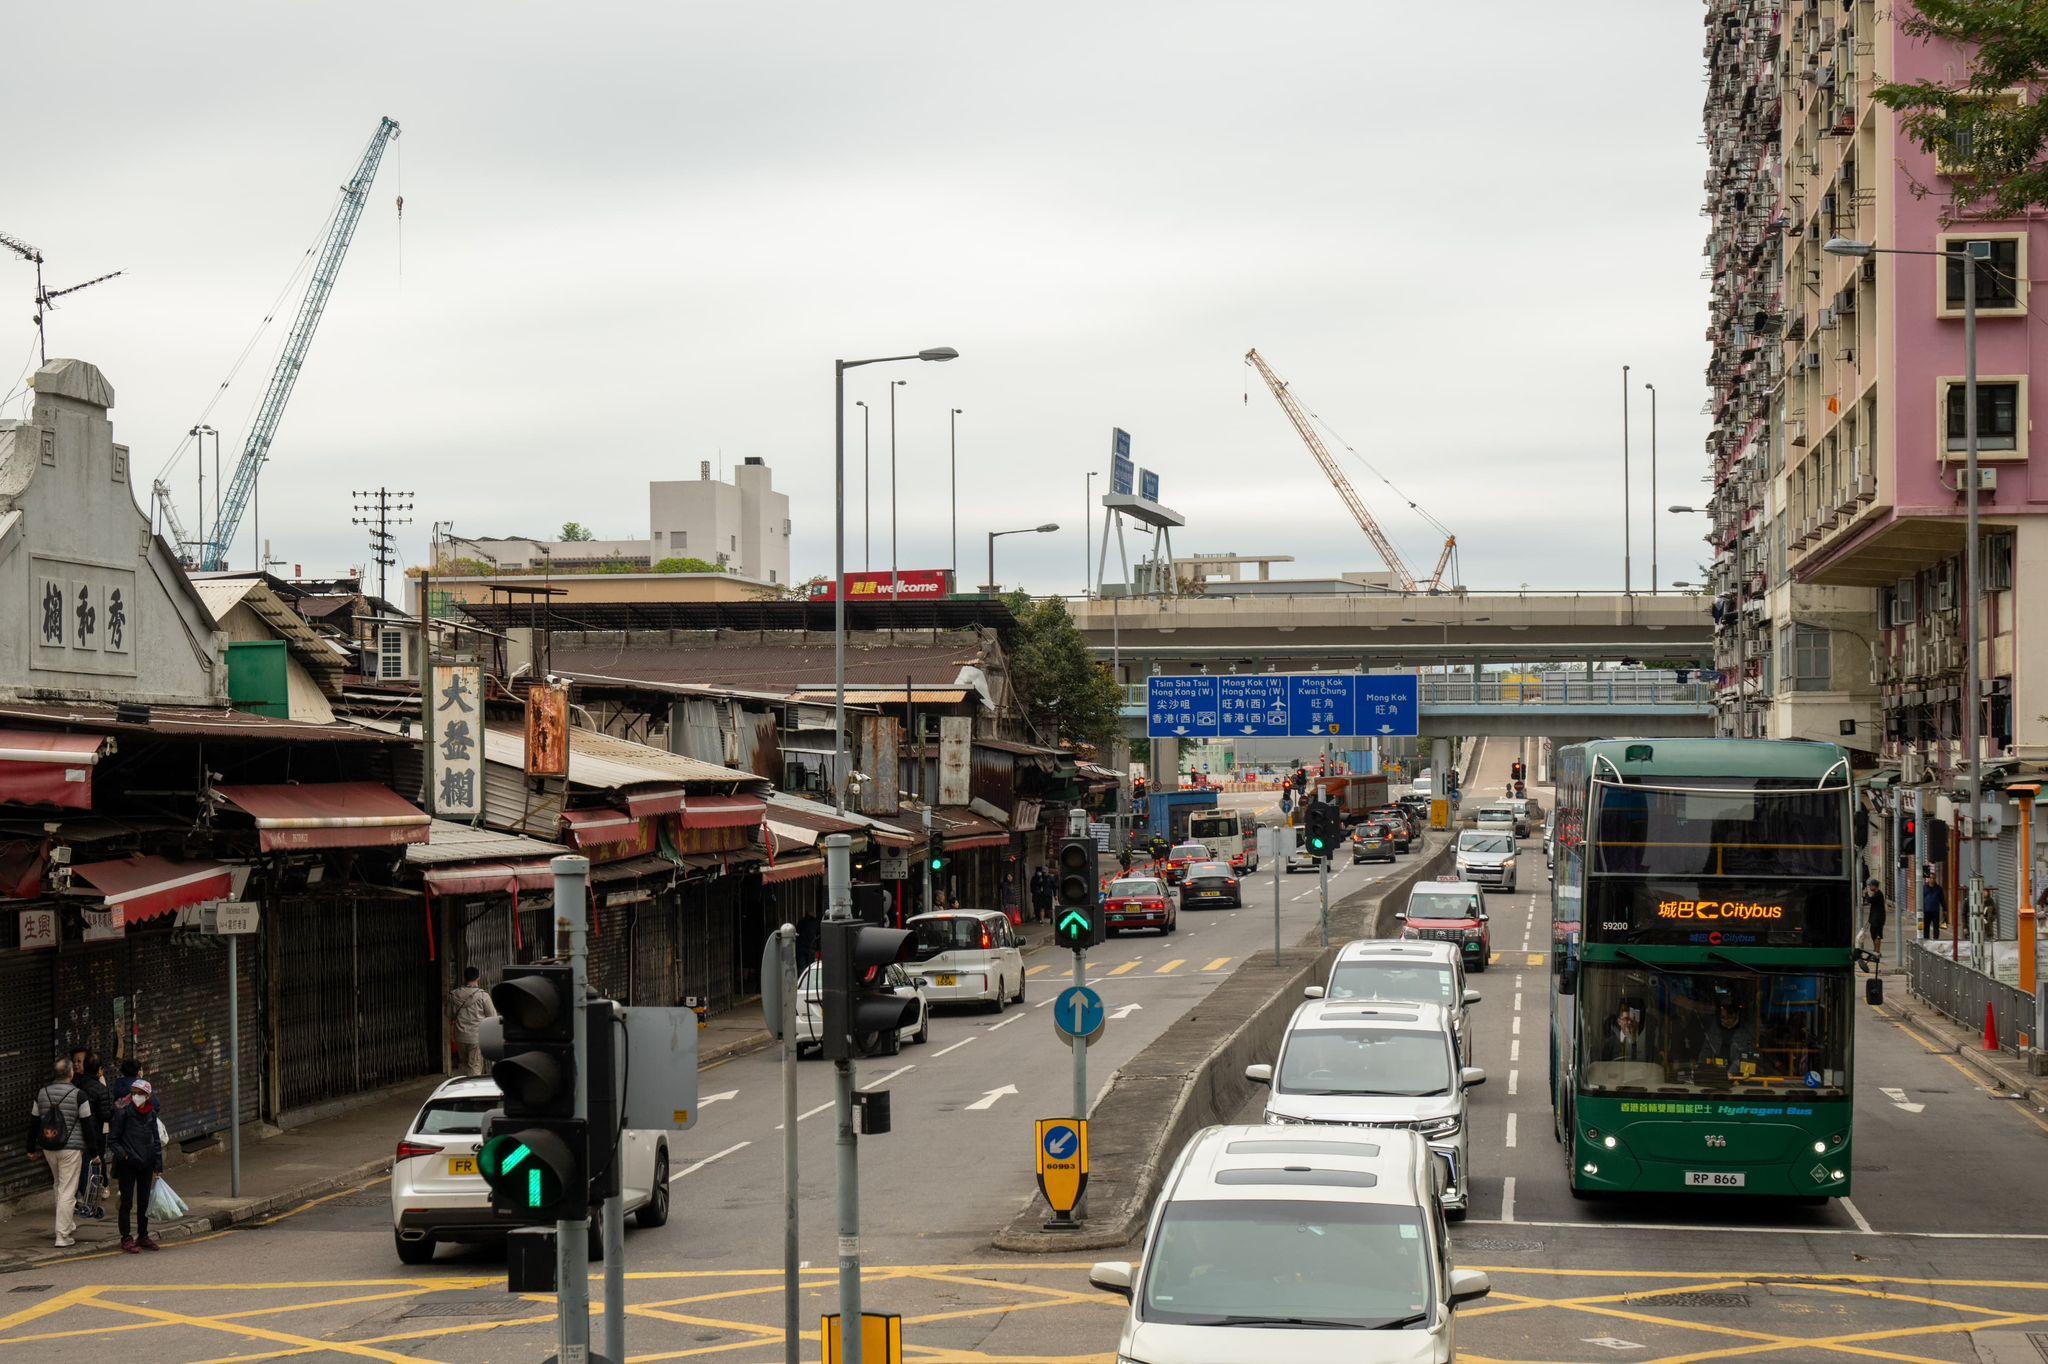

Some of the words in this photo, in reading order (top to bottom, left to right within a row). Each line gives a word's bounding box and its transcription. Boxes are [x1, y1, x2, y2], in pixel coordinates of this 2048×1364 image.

[850, 582, 878, 594] 惠康
[878, 580, 938, 593] wellcome
[1155, 679, 1174, 688] Tsim
[1175, 679, 1191, 688] Sha
[1193, 679, 1210, 687] Tsui
[1222, 679, 1246, 688] Mong
[1247, 679, 1264, 687] Kok
[1265, 678, 1283, 688] (W)
[1302, 678, 1326, 688] Mong
[1326, 678, 1343, 687] Kok
[1151, 688, 1173, 698] Hong
[1174, 688, 1196, 698] Kong
[1197, 687, 1214, 697] (W)
[1221, 687, 1243, 697] Hong
[1244, 687, 1267, 697] Kong
[1268, 687, 1285, 697] (W)
[1298, 687, 1319, 696] Kwai
[1320, 686, 1347, 697] Chung
[1311, 698, 1334, 709] 旺角
[1366, 693, 1390, 703] Mong
[1391, 693, 1407, 702] Kok
[1156, 699, 1191, 710] 尖沙咀
[1375, 704, 1398, 715] 旺角
[1312, 712, 1334, 723] 葵涌
[1331, 725, 1338, 734] 5
[437, 673, 475, 809] 大益欄
[1658, 900, 1694, 919] 城巴
[1720, 902, 1783, 920] Citybus
[1602, 921, 1628, 931] 59200
[1722, 933, 1756, 943] Citybus
[1717, 1105, 1784, 1117] Hydrogen
[1786, 1106, 1813, 1116] Bus
[455, 1160, 472, 1172] FR
[1692, 1173, 1709, 1184] RP
[1713, 1174, 1738, 1185] 866
